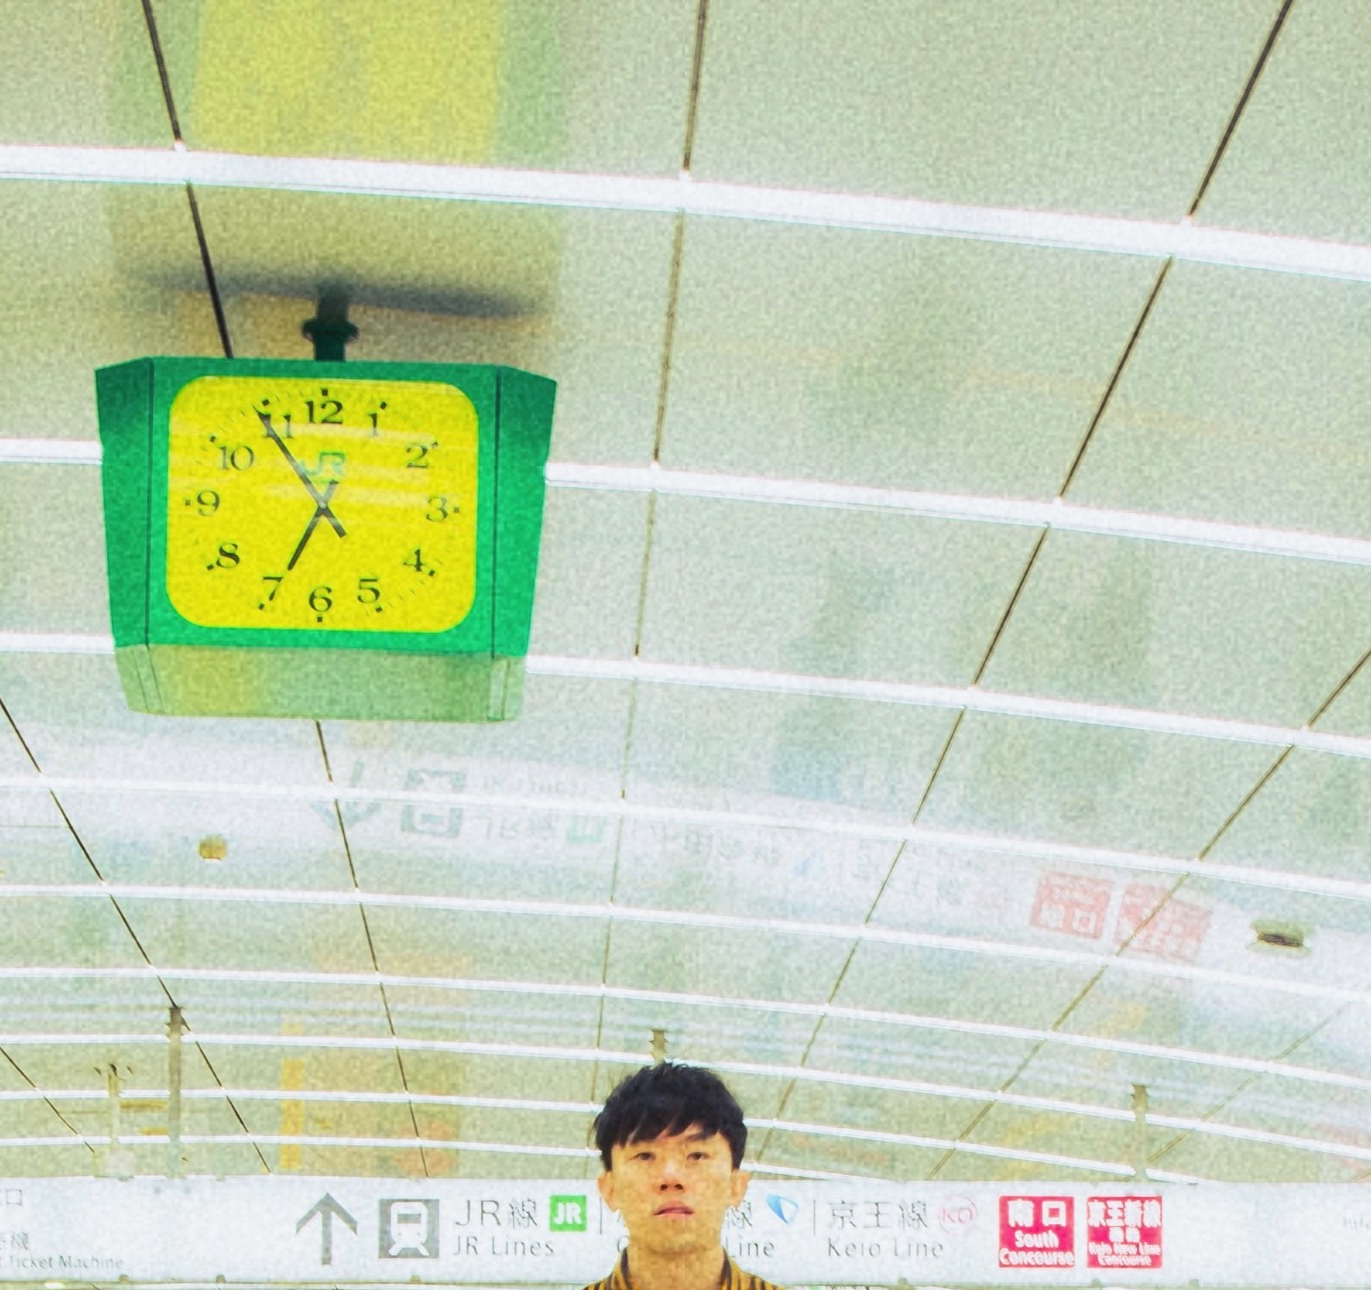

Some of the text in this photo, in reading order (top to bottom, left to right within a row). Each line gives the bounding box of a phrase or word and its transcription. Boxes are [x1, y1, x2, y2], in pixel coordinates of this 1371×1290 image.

[304, 400, 344, 425] 12
[367, 412, 380, 437] 1
[220, 445, 255, 471] 10
[298, 451, 345, 477] JR
[405, 442, 429, 469] 2
[196, 490, 220, 517] 9
[425, 496, 449, 523] 3
[216, 543, 240, 569] 8
[403, 549, 428, 573] 4
[262, 576, 284, 602] 7
[309, 587, 333, 613] 6
[356, 578, 381, 604] 5
[455, 1199, 538, 1228] JR線
[553, 1203, 583, 1225] JR
[828, 1200, 928, 1230] 京王線
[1007, 1199, 1067, 1227] 南口
[453, 1234, 555, 1257] JR Lines
[725, 1235, 775, 1258] Line
[828, 1238, 944, 1258] Keio Line
[1014, 1229, 1059, 1248] South
[59, 1255, 124, 1269] Machine
[999, 1247, 1075, 1266] Concourse
